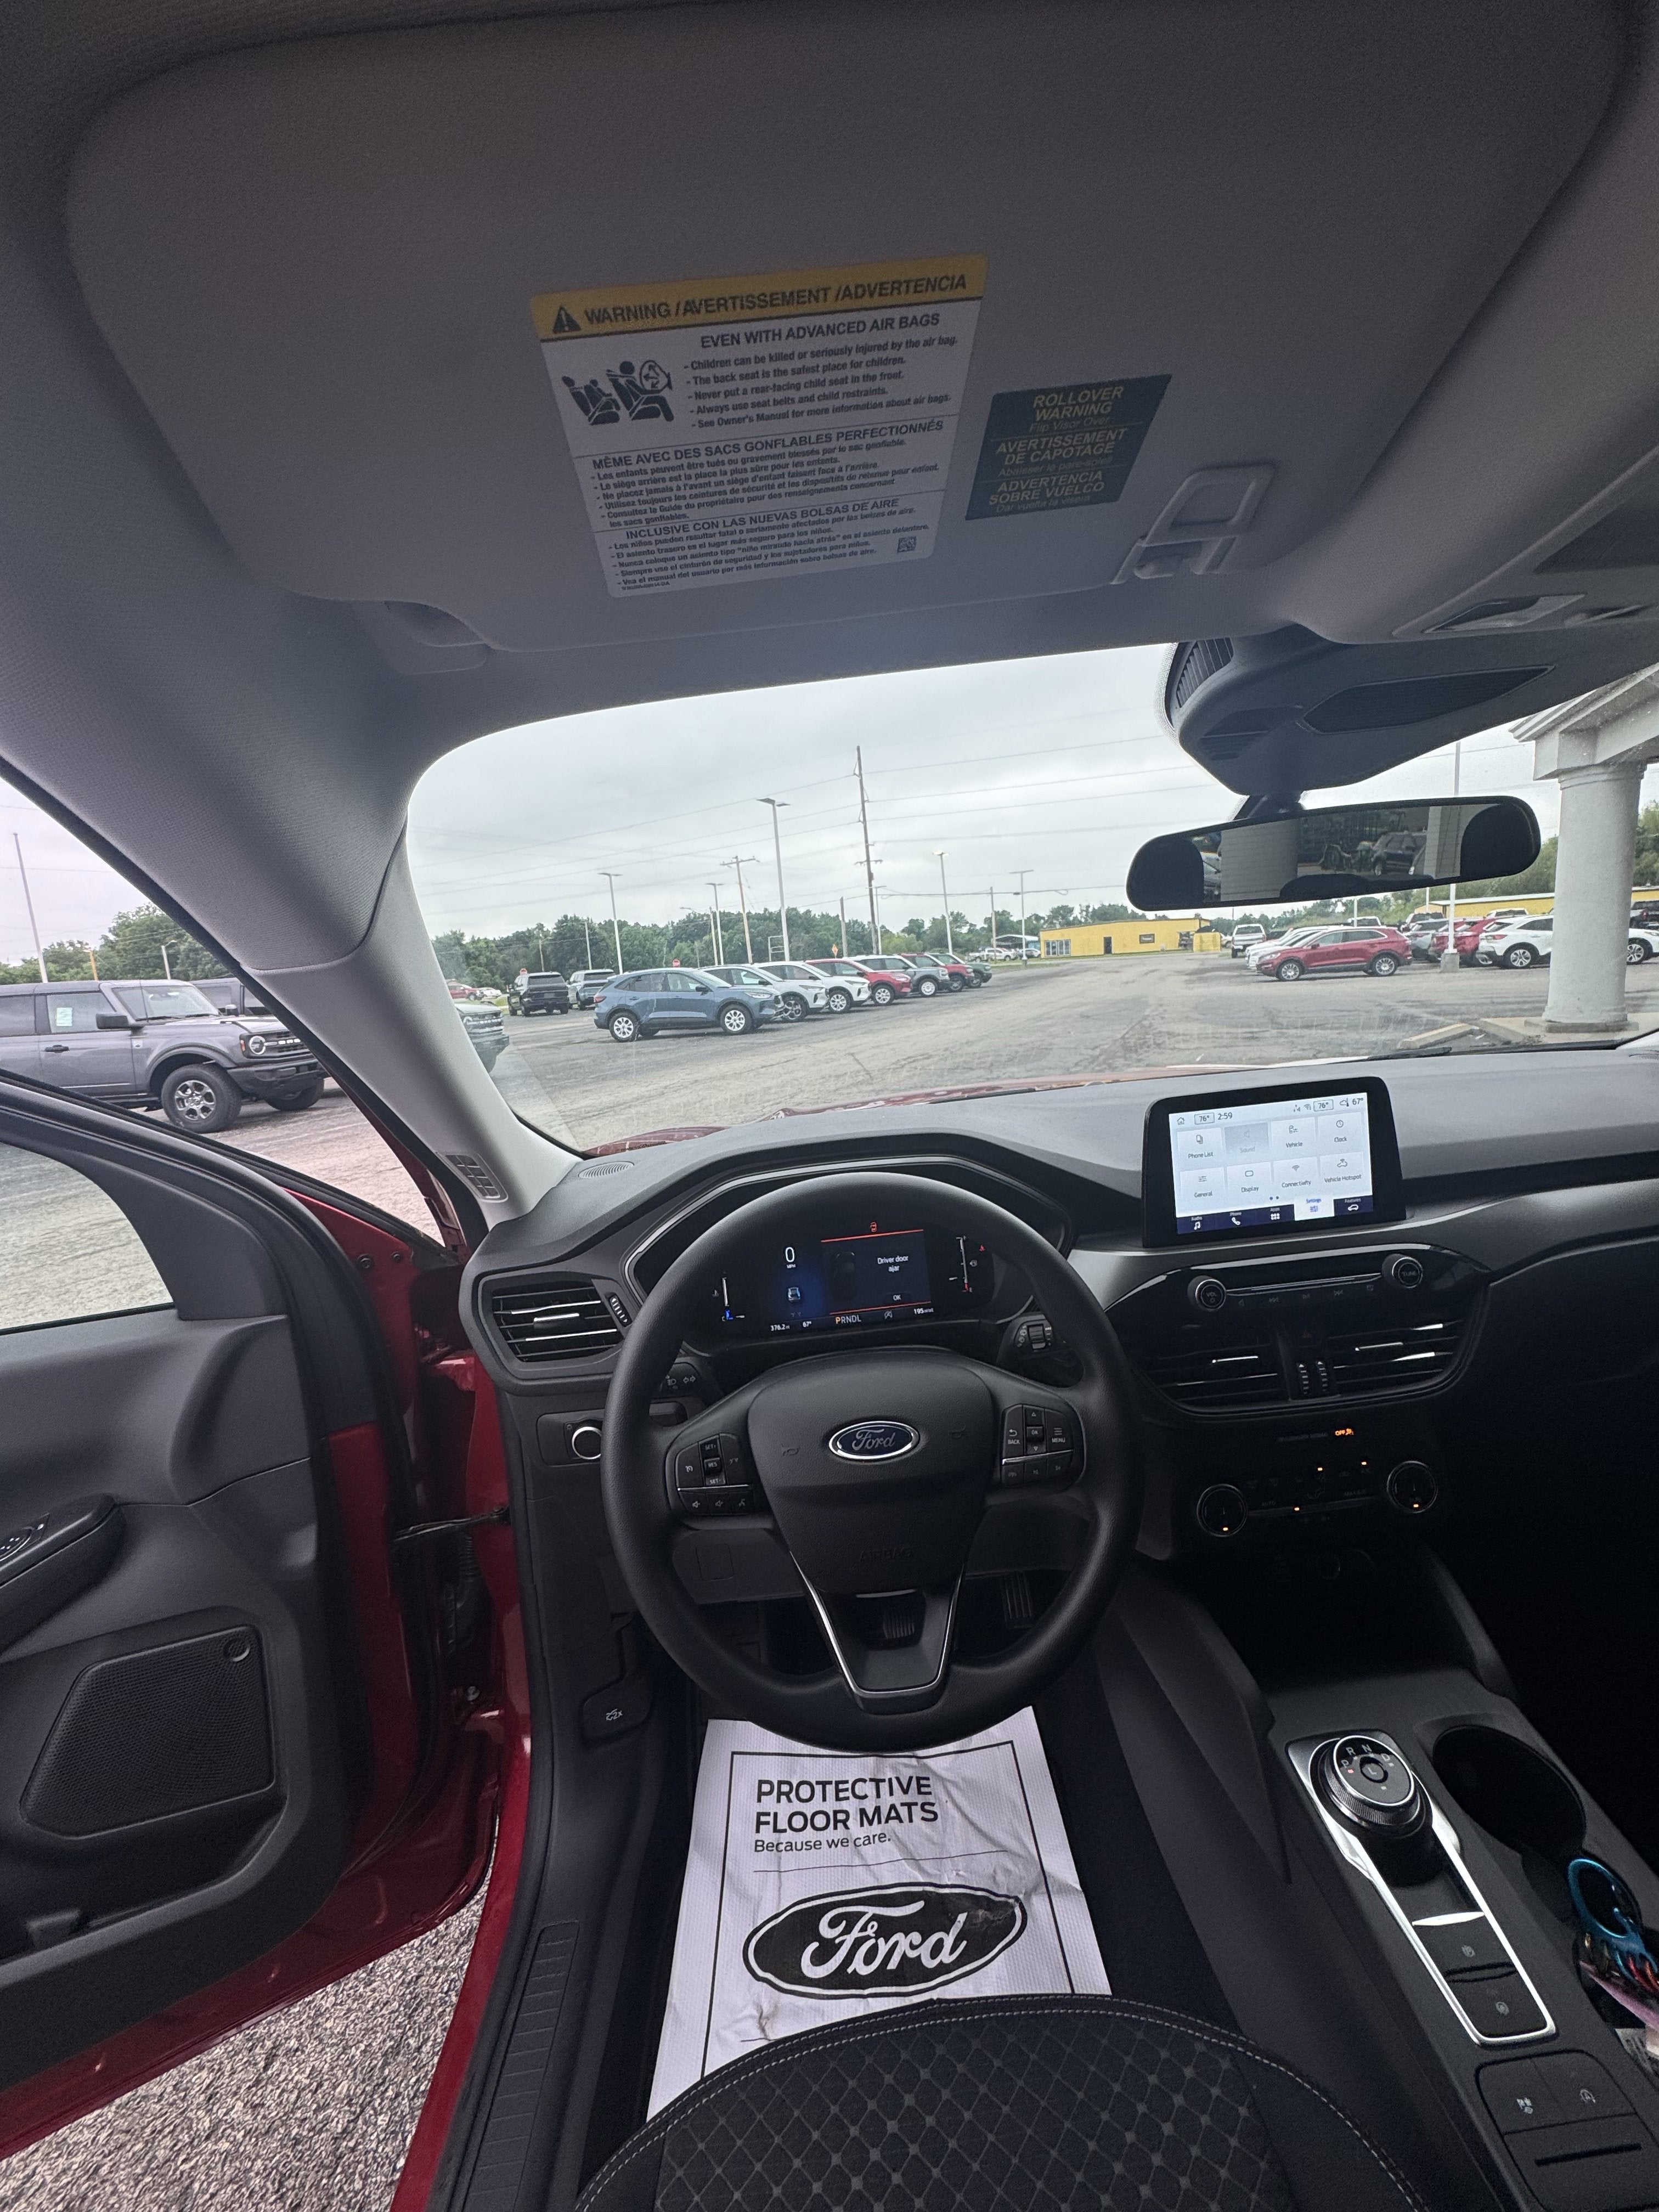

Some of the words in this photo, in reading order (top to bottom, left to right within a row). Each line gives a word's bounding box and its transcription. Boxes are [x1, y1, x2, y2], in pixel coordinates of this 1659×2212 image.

[584, 303, 671, 324] WARNING
[700, 332, 740, 347] EVEN
[744, 329, 781, 343] WITH
[786, 320, 866, 339] ADVANCED
[870, 318, 894, 330] AIR
[899, 313, 940, 328] BAGS
[691, 357, 731, 370] Children
[733, 357, 751, 365] can
[754, 353, 765, 363] be
[769, 351, 794, 362] killed
[810, 345, 853, 360] seriously
[855, 341, 888, 356] injured
[890, 340, 902, 352] by
[905, 338, 920, 348] the
[923, 336, 935, 346] air
[693, 375, 710, 385] The
[713, 372, 736, 383] back
[738, 370, 759, 380] seat
[761, 369, 770, 378] is
[773, 366, 788, 377] the
[791, 364, 819, 375] safest
[822, 360, 847, 374] place
[850, 359, 862, 369] for
[694, 389, 720, 400] Never
[723, 388, 740, 399] put
[804, 378, 826, 388] child
[828, 376, 848, 386] seat
[851, 374, 860, 383] in
[862, 373, 877, 382] the
[1033, 386, 1124, 408] ROLLOVER
[696, 402, 729, 416] Always
[751, 399, 770, 408] seat
[772, 396, 795, 406] belts
[798, 393, 815, 403] and
[817, 391, 839, 401] child
[697, 419, 714, 428] See
[756, 410, 789, 421] Manual
[791, 409, 804, 417] for
[806, 408, 829, 416] more
[885, 397, 911, 408] about
[913, 396, 925, 405] air
[1034, 402, 1113, 421] WARNING
[1051, 419, 1080, 430] Visor
[1083, 415, 1110, 426] Over
[591, 453, 632, 468] MÊME
[635, 451, 670, 464] AVEC
[674, 448, 701, 459] DES
[704, 443, 740, 456] SACS
[744, 433, 832, 452] GONFLABLES
[836, 419, 944, 442] PERFECTIONNÉS
[996, 428, 1127, 453] AVERTISSEMENT
[1005, 453, 1025, 465] DE
[1030, 442, 1115, 462] CAPOTAGE
[989, 489, 1040, 505] SOBRE
[1045, 481, 1105, 498] VUELCO
[997, 470, 1104, 492] ADVERTENCIA
[625, 523, 689, 538] INCLUSIVE
[692, 520, 719, 530] CON
[723, 517, 746, 527] LAS
[749, 511, 797, 523] NUEVAS
[800, 505, 849, 517] BOLSAS
[852, 503, 868, 511] DE
[871, 499, 899, 509] AIRE
[1217, 1112, 1233, 1120] 2:59
[785, 1246, 795, 1262] 0
[877, 1256, 895, 1264] Driver
[895, 1255, 909, 1263] door
[888, 1265, 900, 1273] ajar
[851, 1428, 896, 1451] Ford
[757, 1775, 932, 1803] PROTECTIVE
[755, 1809, 850, 1834] FLOOR
[859, 1802, 939, 1827] MATS
[754, 1838, 822, 1853] Because
[825, 1837, 850, 1849] we
[854, 1833, 891, 1847] care.
[800, 1900, 968, 1979] Ford
